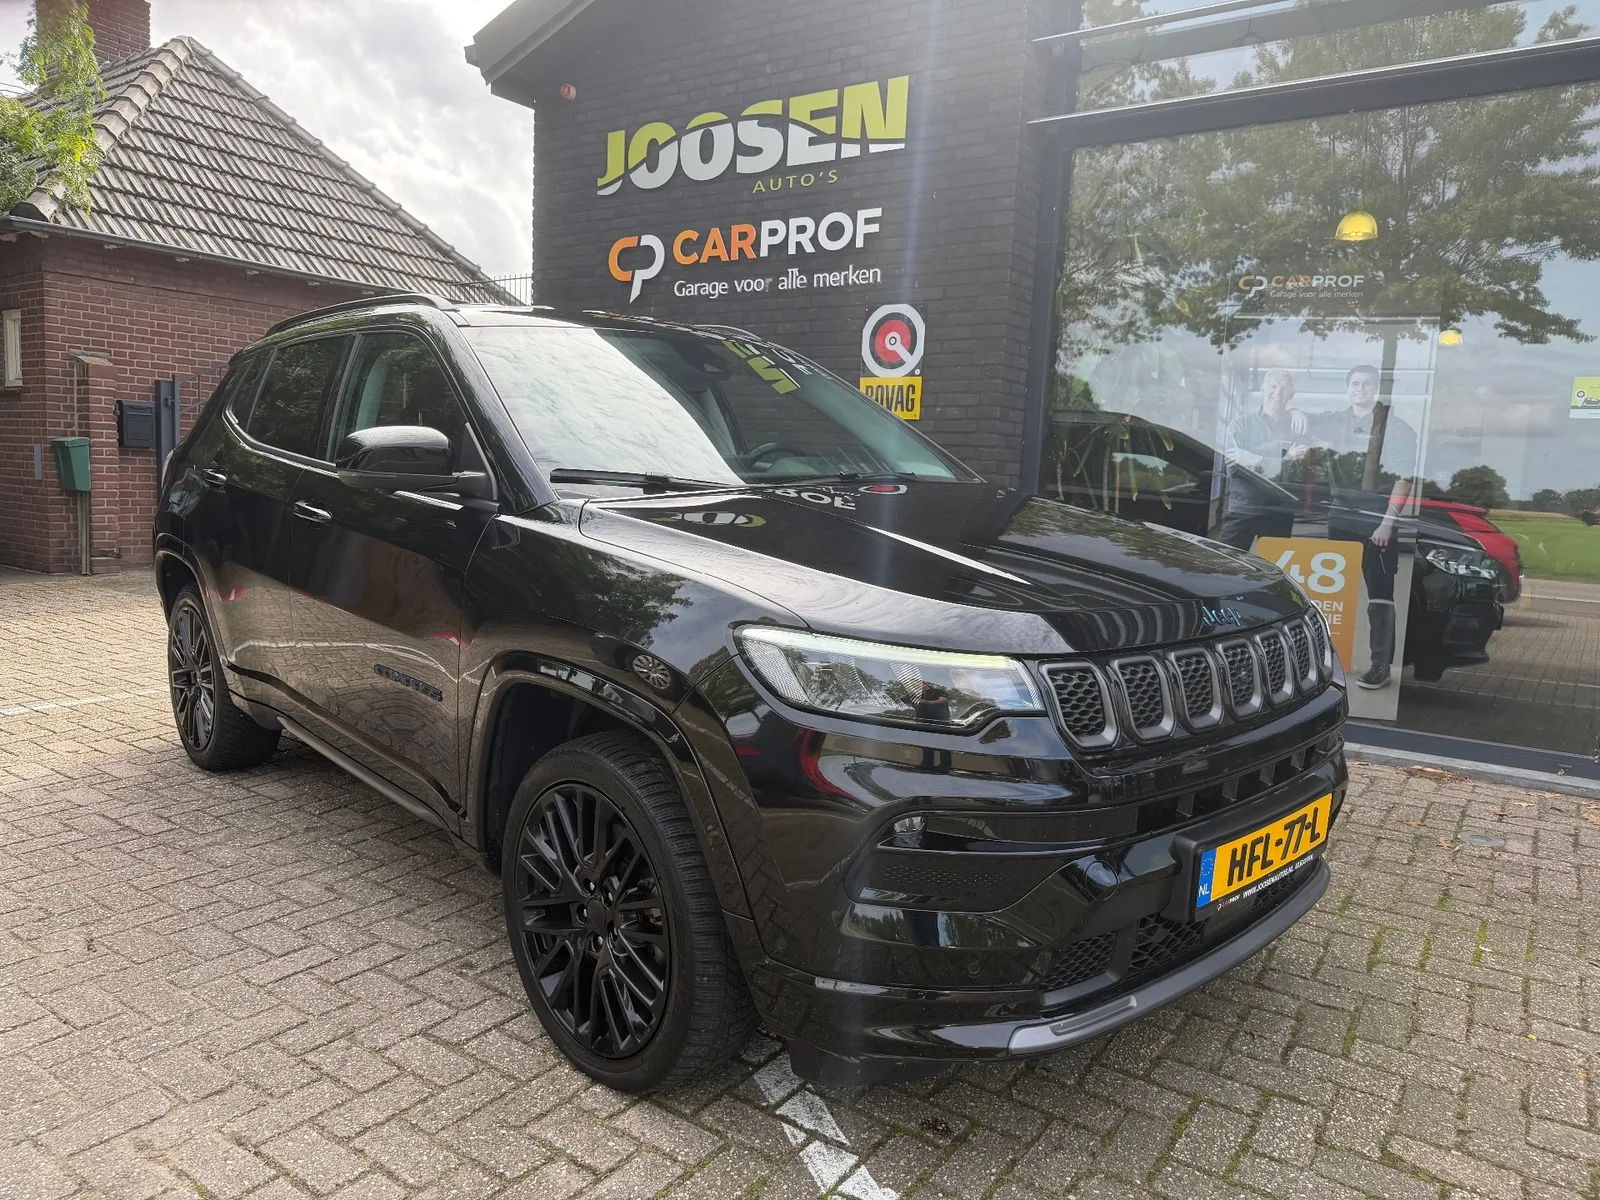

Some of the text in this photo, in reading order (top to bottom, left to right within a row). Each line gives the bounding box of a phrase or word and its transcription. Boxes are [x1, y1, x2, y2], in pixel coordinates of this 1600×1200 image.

[597, 75, 909, 196] JOOSEN
[752, 169, 838, 194] AUTO'S
[673, 207, 882, 265] CARPROF
[673, 265, 881, 299] Garage voor alle merken
[1270, 290, 1297, 299] Garage
[1318, 290, 1332, 298] alle
[1334, 290, 1363, 298] merken
[1271, 275, 1365, 288] CARPROF
[1275, 550, 1347, 594] 48
[1312, 600, 1344, 612] DEN
[1227, 807, 1321, 887] HFL-77-L
[1199, 883, 1210, 898] NL
